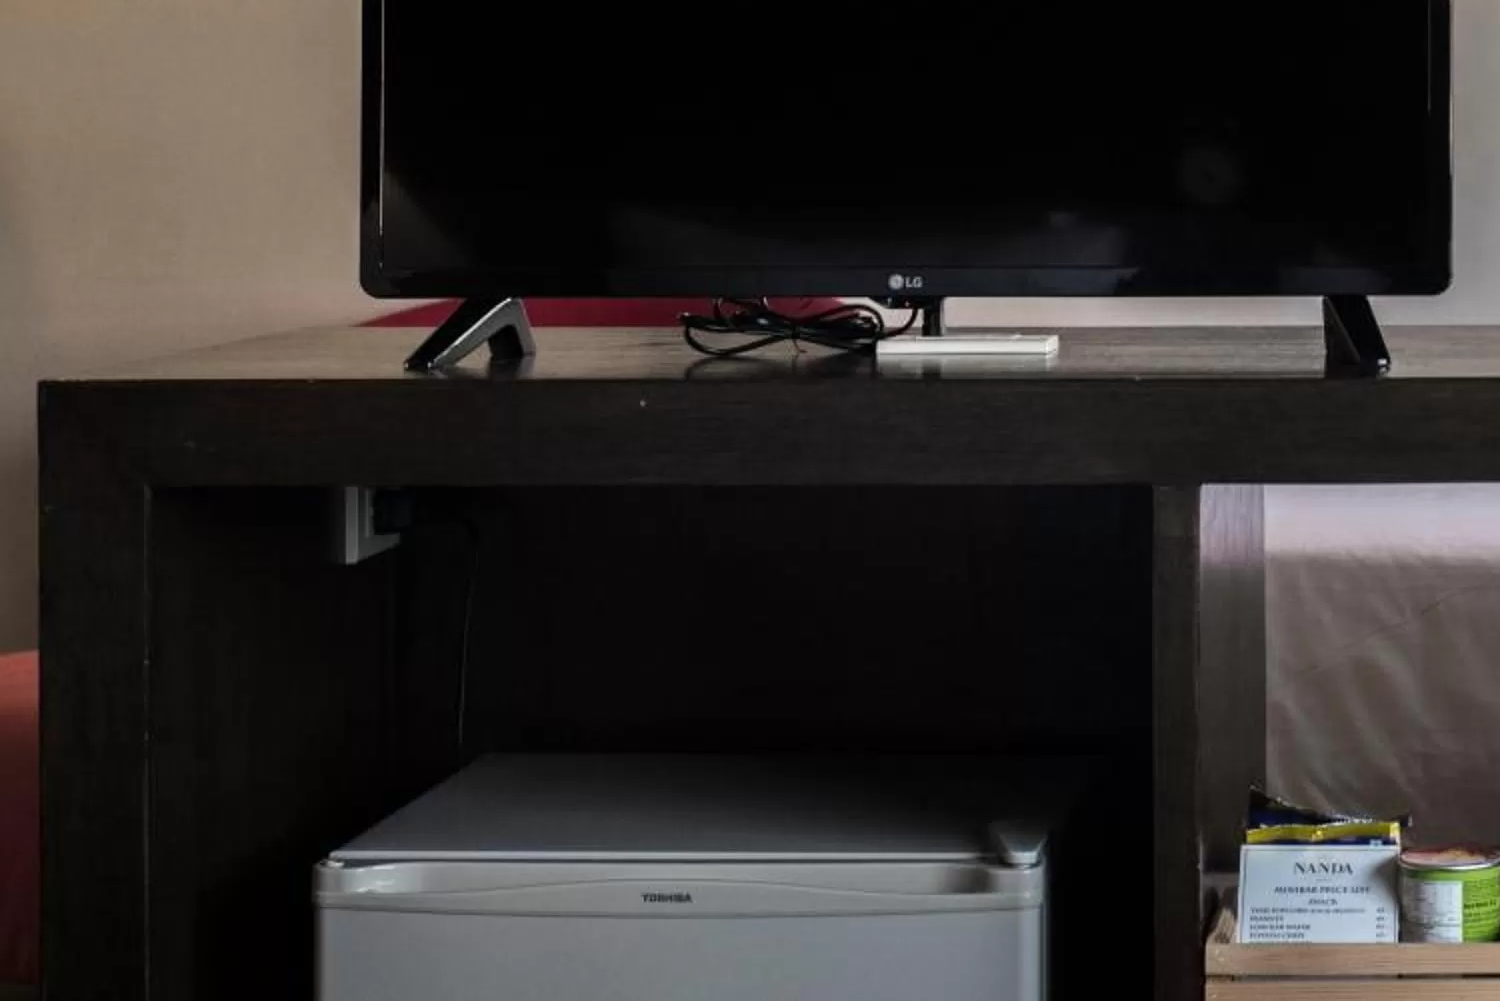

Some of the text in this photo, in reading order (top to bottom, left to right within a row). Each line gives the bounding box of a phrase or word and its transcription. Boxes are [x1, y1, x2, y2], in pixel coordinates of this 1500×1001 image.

[905, 276, 923, 288] LG
[1293, 861, 1354, 876] NANDA
[641, 892, 693, 904] TOSHIBA
